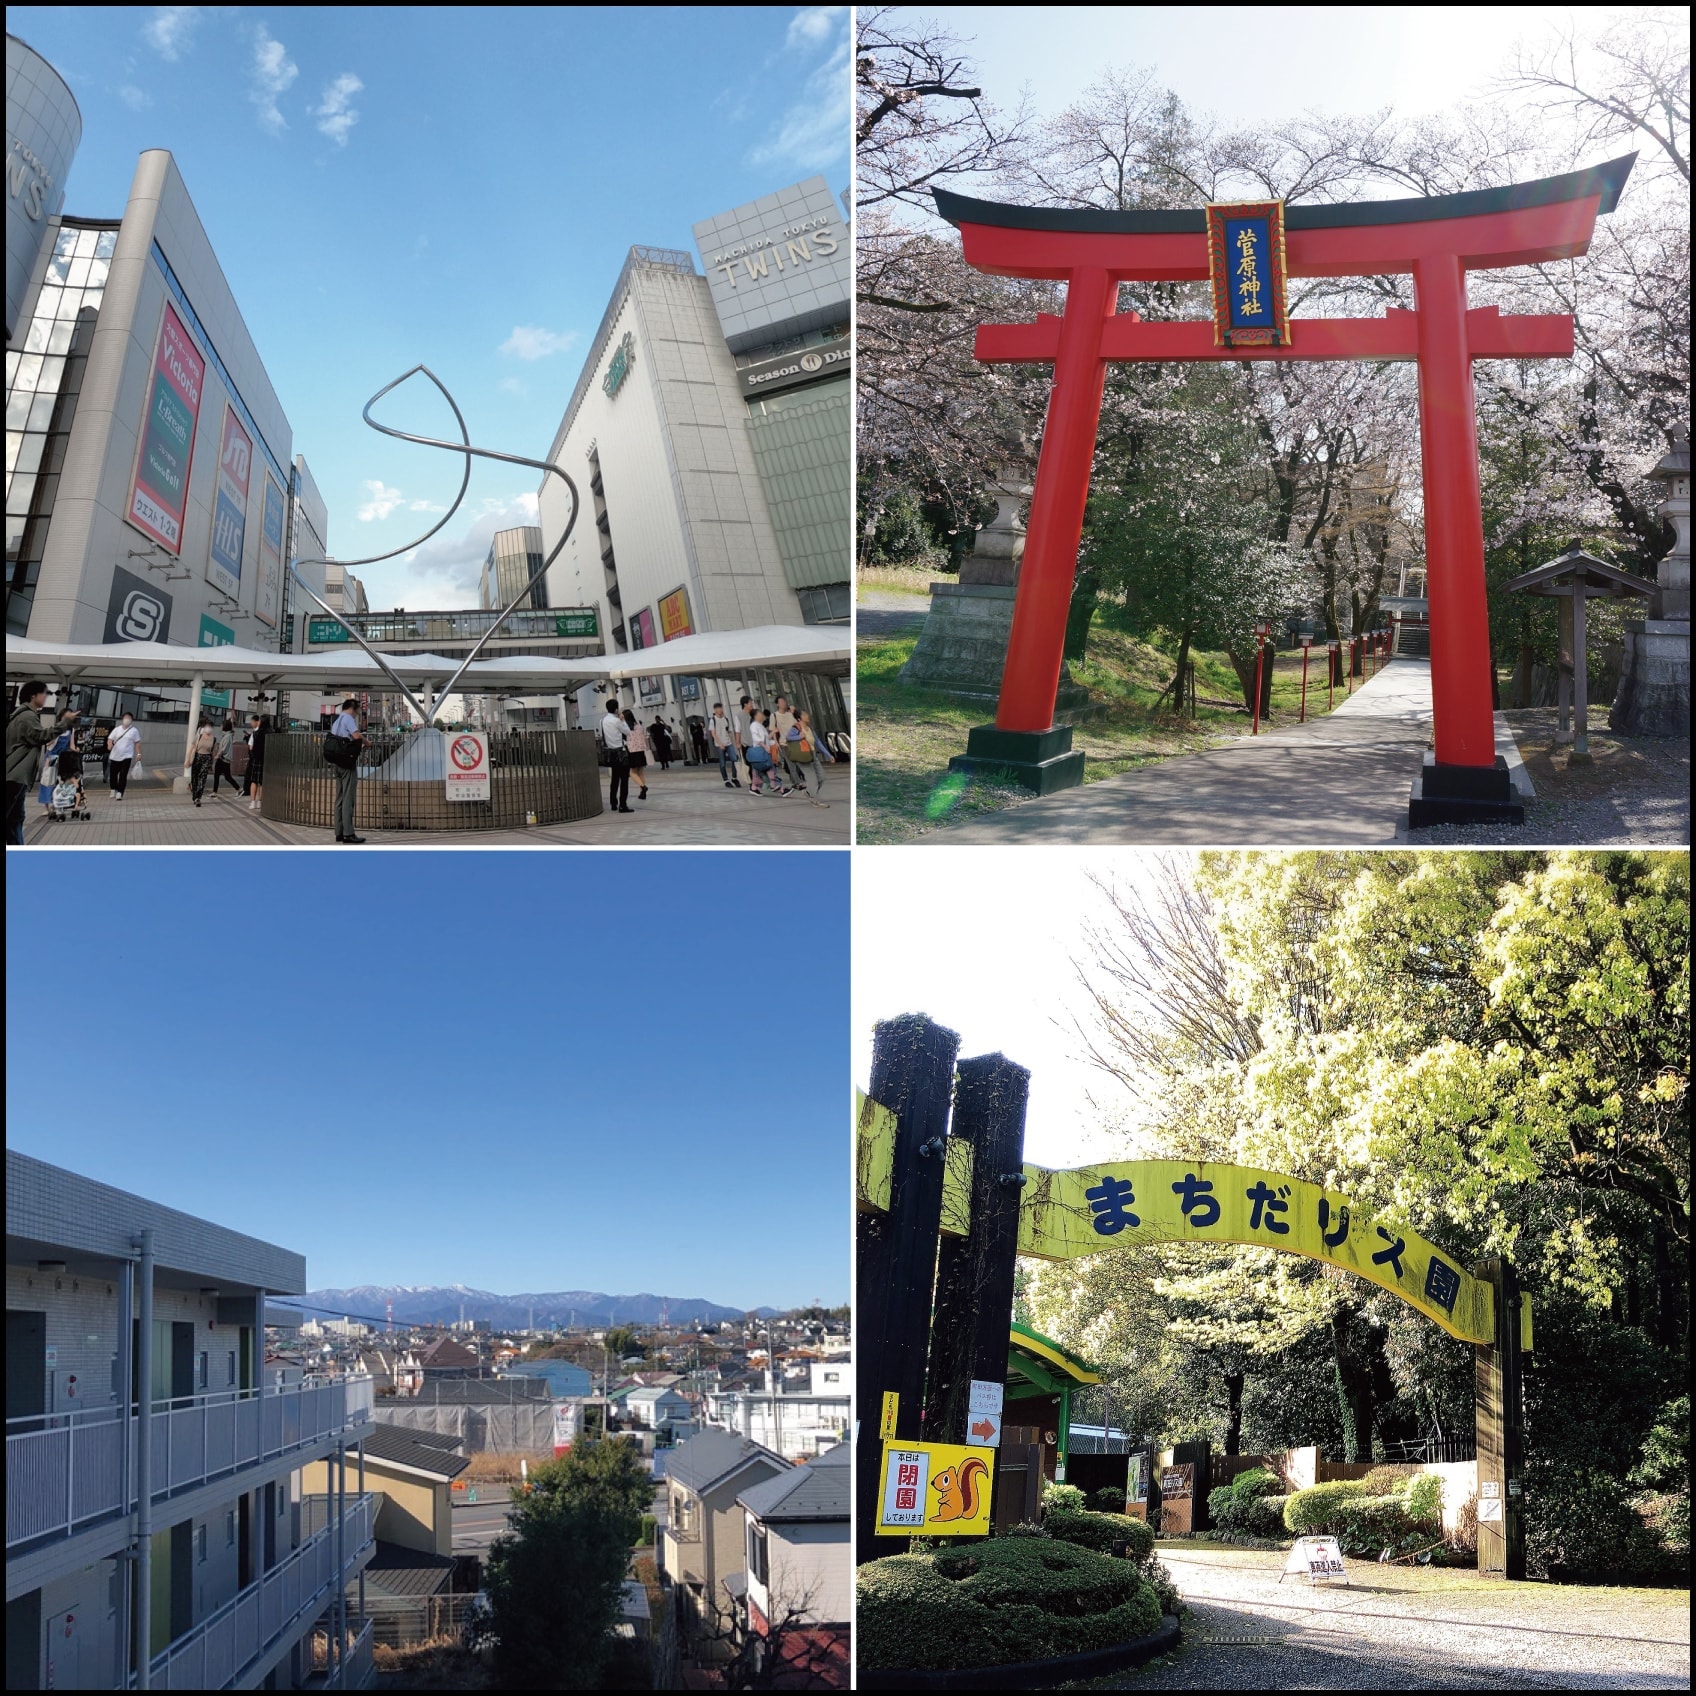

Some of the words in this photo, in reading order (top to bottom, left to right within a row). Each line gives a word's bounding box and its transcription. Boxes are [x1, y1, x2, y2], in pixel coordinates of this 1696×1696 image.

[714, 237, 774, 264] MACHIDA
[783, 215, 828, 238] TOKYU
[717, 228, 838, 289] TWINS
[1236, 228, 1263, 317] 菅原神社
[163, 334, 198, 406] Victoria
[747, 364, 801, 386] Season
[823, 349, 851, 364] Din
[222, 425, 249, 482] JTB
[136, 498, 159, 524] ウエスト
[1085, 1173, 1462, 1313] まちだリス園
[897, 1453, 920, 1462] 本日は
[896, 1464, 919, 1510] 閉園
[886, 1513, 924, 1523] しております
